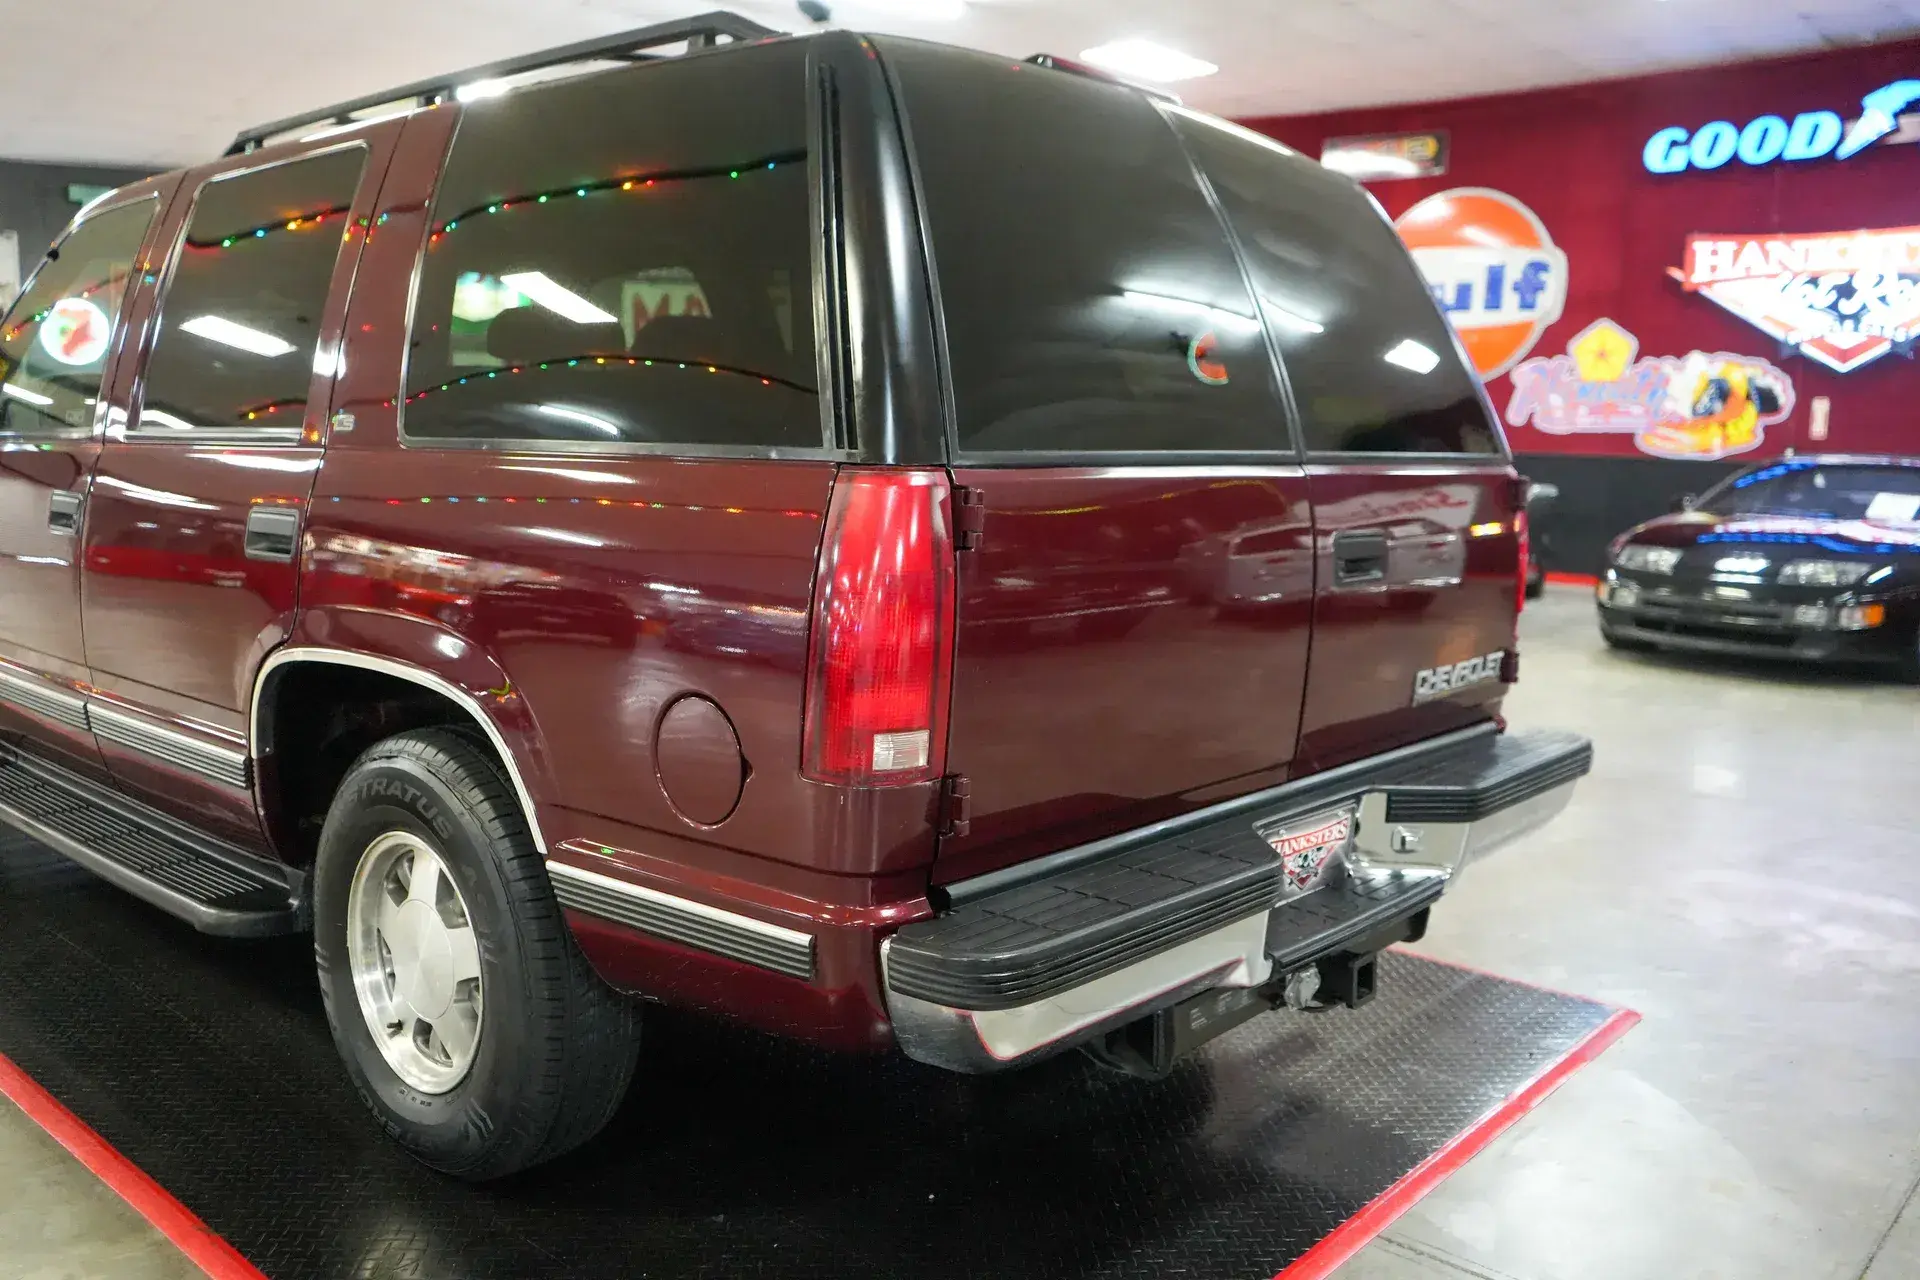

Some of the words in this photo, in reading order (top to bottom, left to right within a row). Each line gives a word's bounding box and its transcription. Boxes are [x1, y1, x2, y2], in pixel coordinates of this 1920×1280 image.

[1642, 110, 1843, 174] GOOD
[1429, 261, 1550, 312] ulf
[1415, 650, 1505, 695] CHEVROLET
[347, 777, 453, 841] STRATUS
